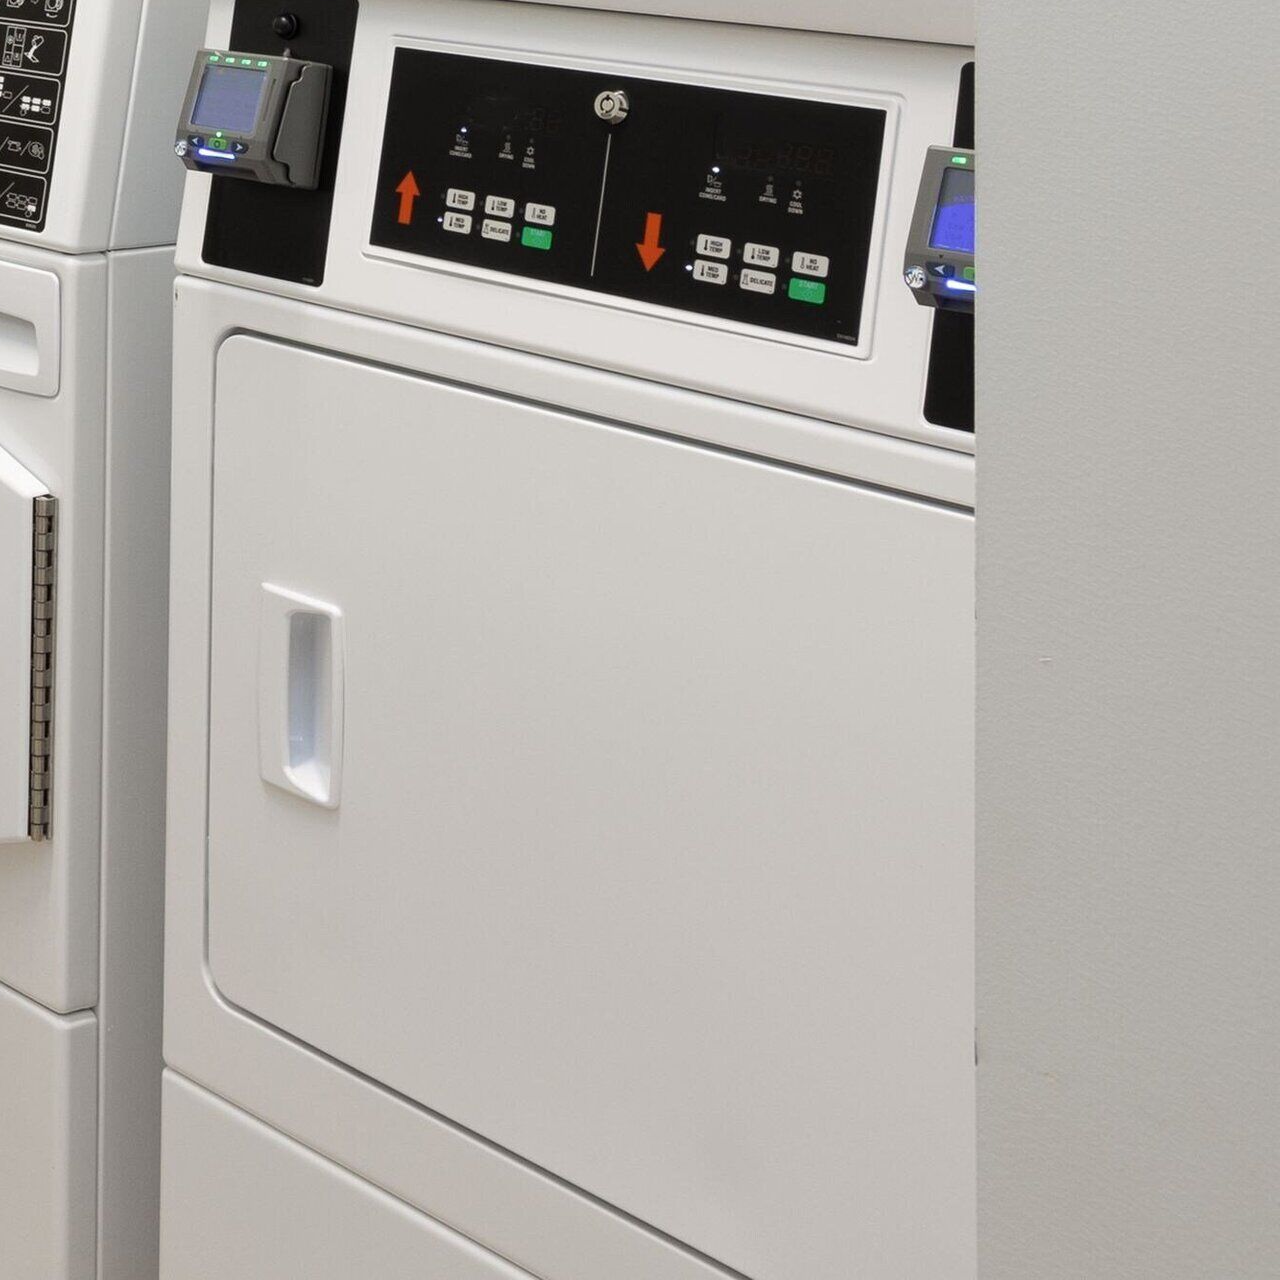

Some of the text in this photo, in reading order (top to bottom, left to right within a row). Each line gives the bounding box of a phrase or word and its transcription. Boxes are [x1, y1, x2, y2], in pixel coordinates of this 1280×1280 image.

[709, 245, 723, 253] TEMP
[707, 265, 719, 273] MED
[705, 271, 720, 279] TEMP
[749, 276, 774, 287] DELICATE
[798, 280, 819, 289] START
